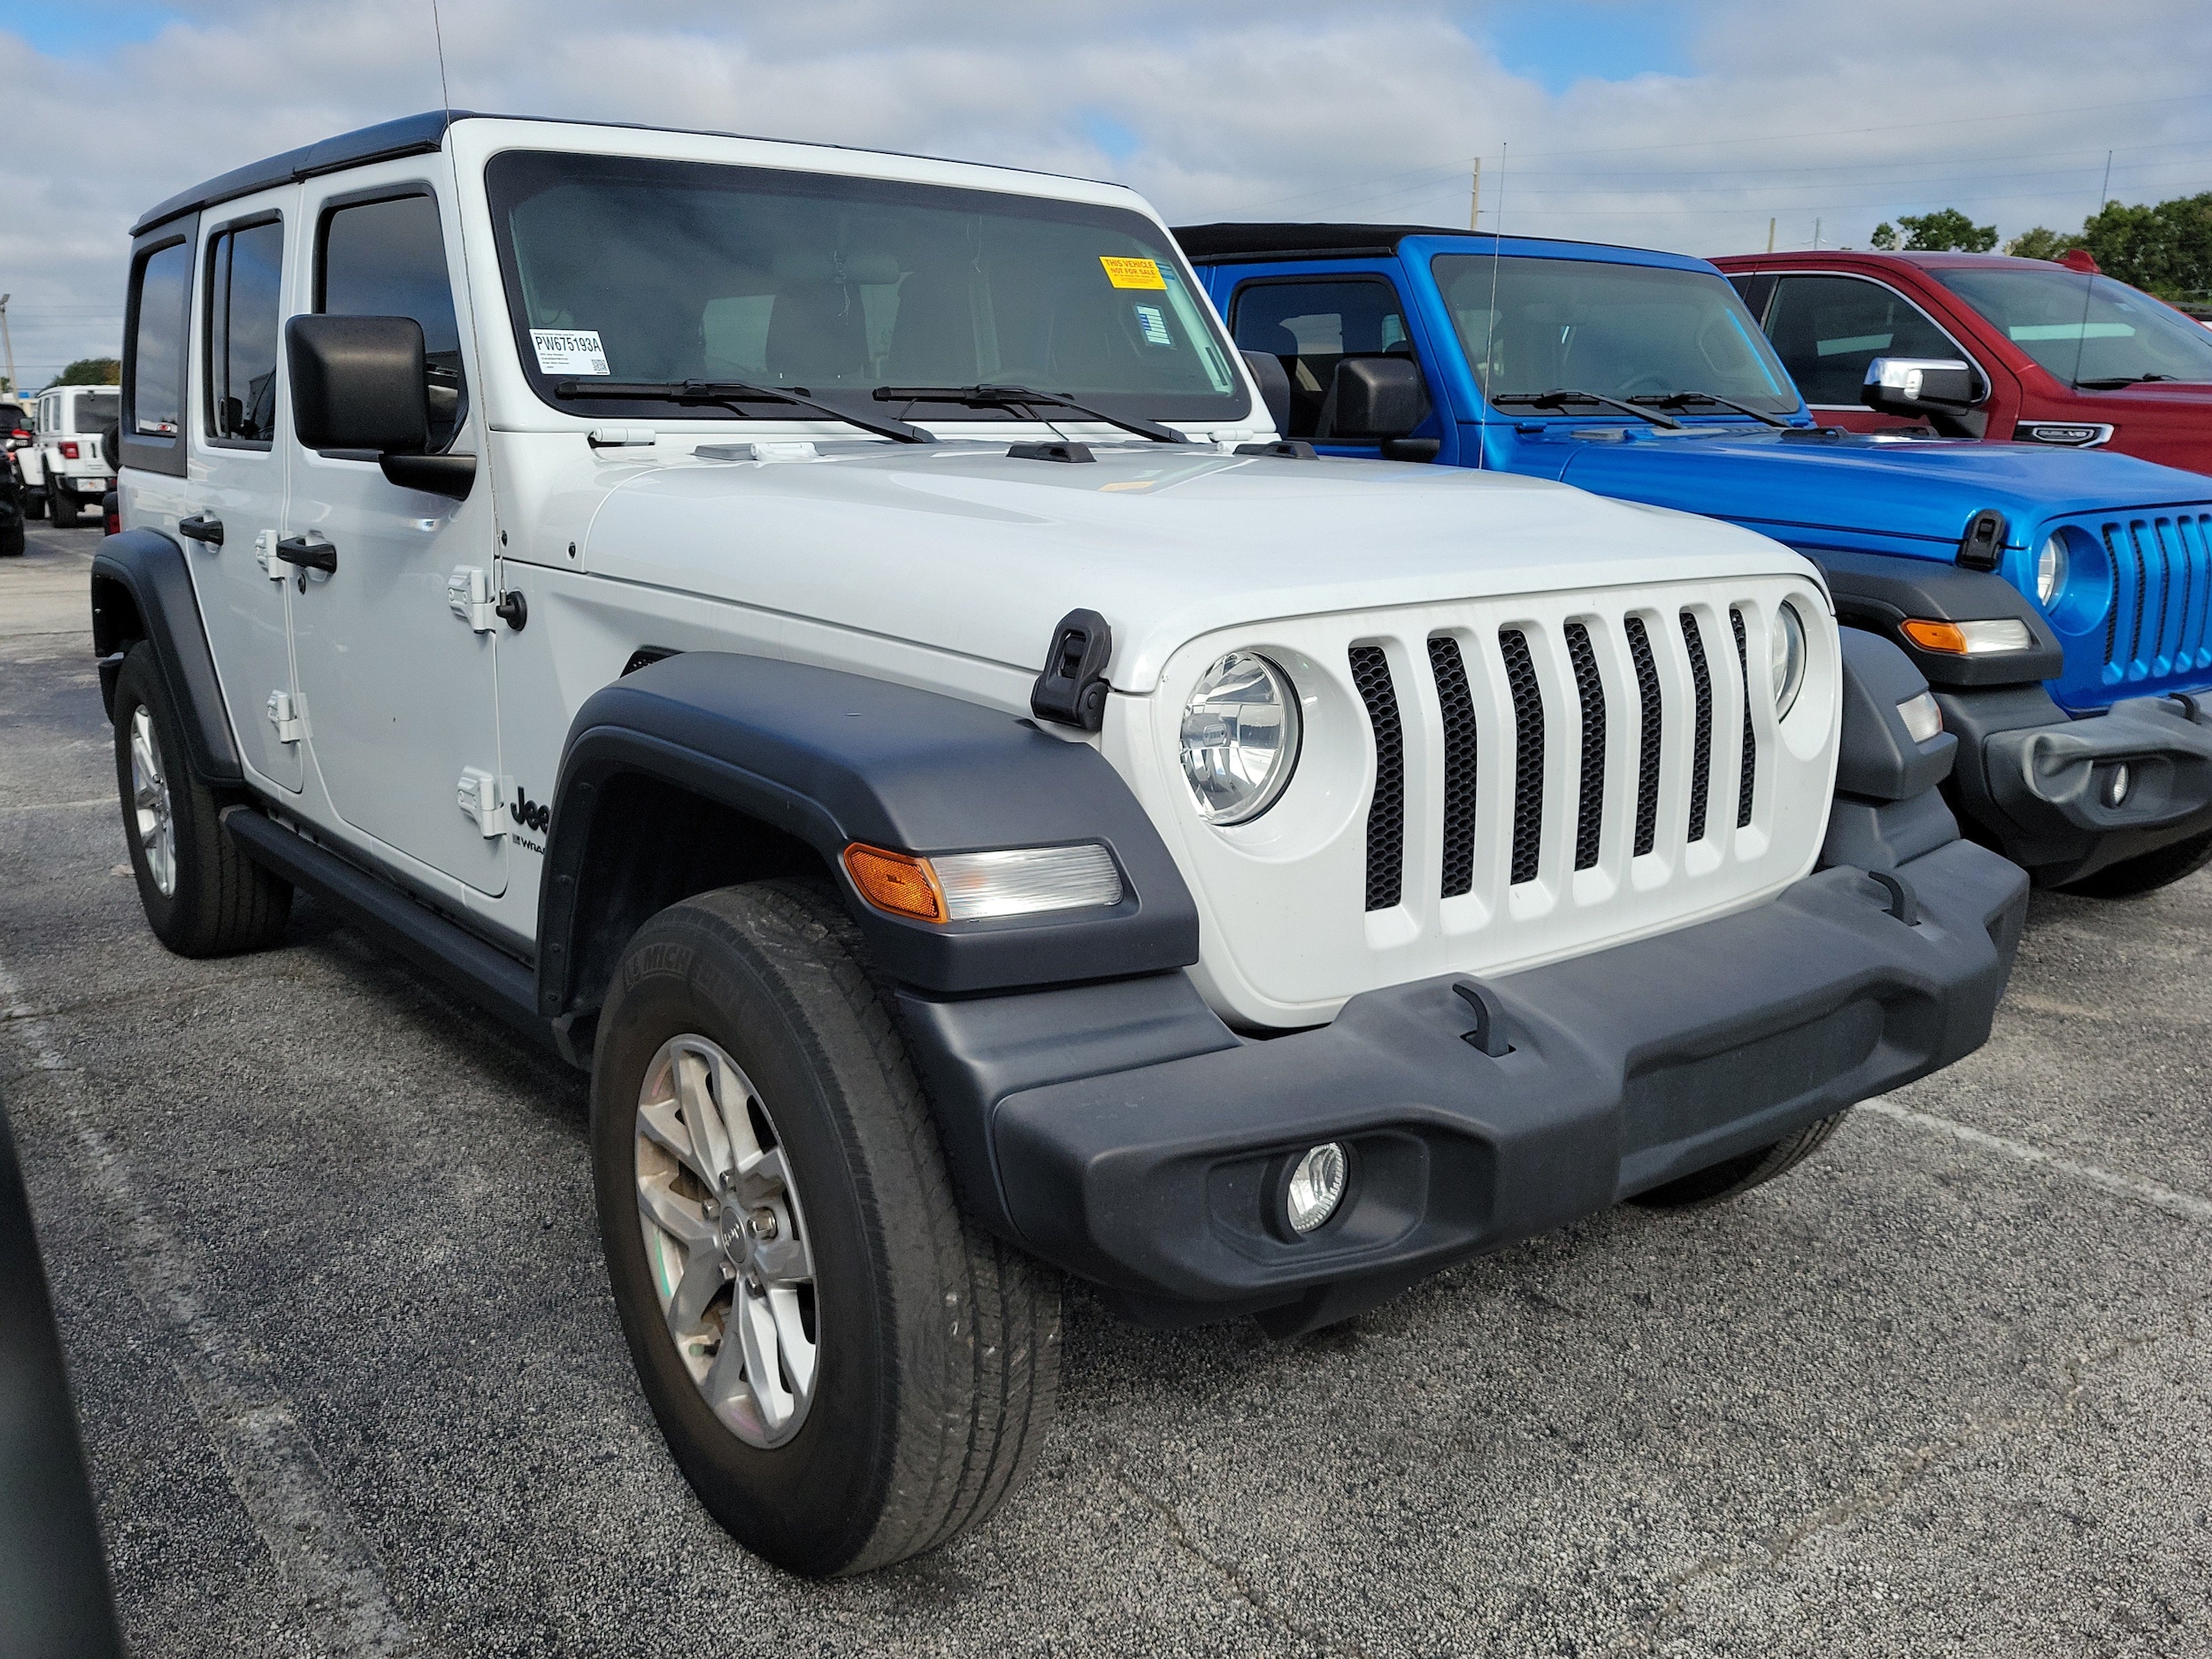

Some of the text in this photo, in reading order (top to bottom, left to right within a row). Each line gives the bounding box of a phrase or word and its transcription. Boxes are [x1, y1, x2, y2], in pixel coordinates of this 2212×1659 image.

[1123, 260, 1155, 269] VEHICLE
[534, 335, 602, 352] PW675193A
[511, 786, 550, 835] Jee
